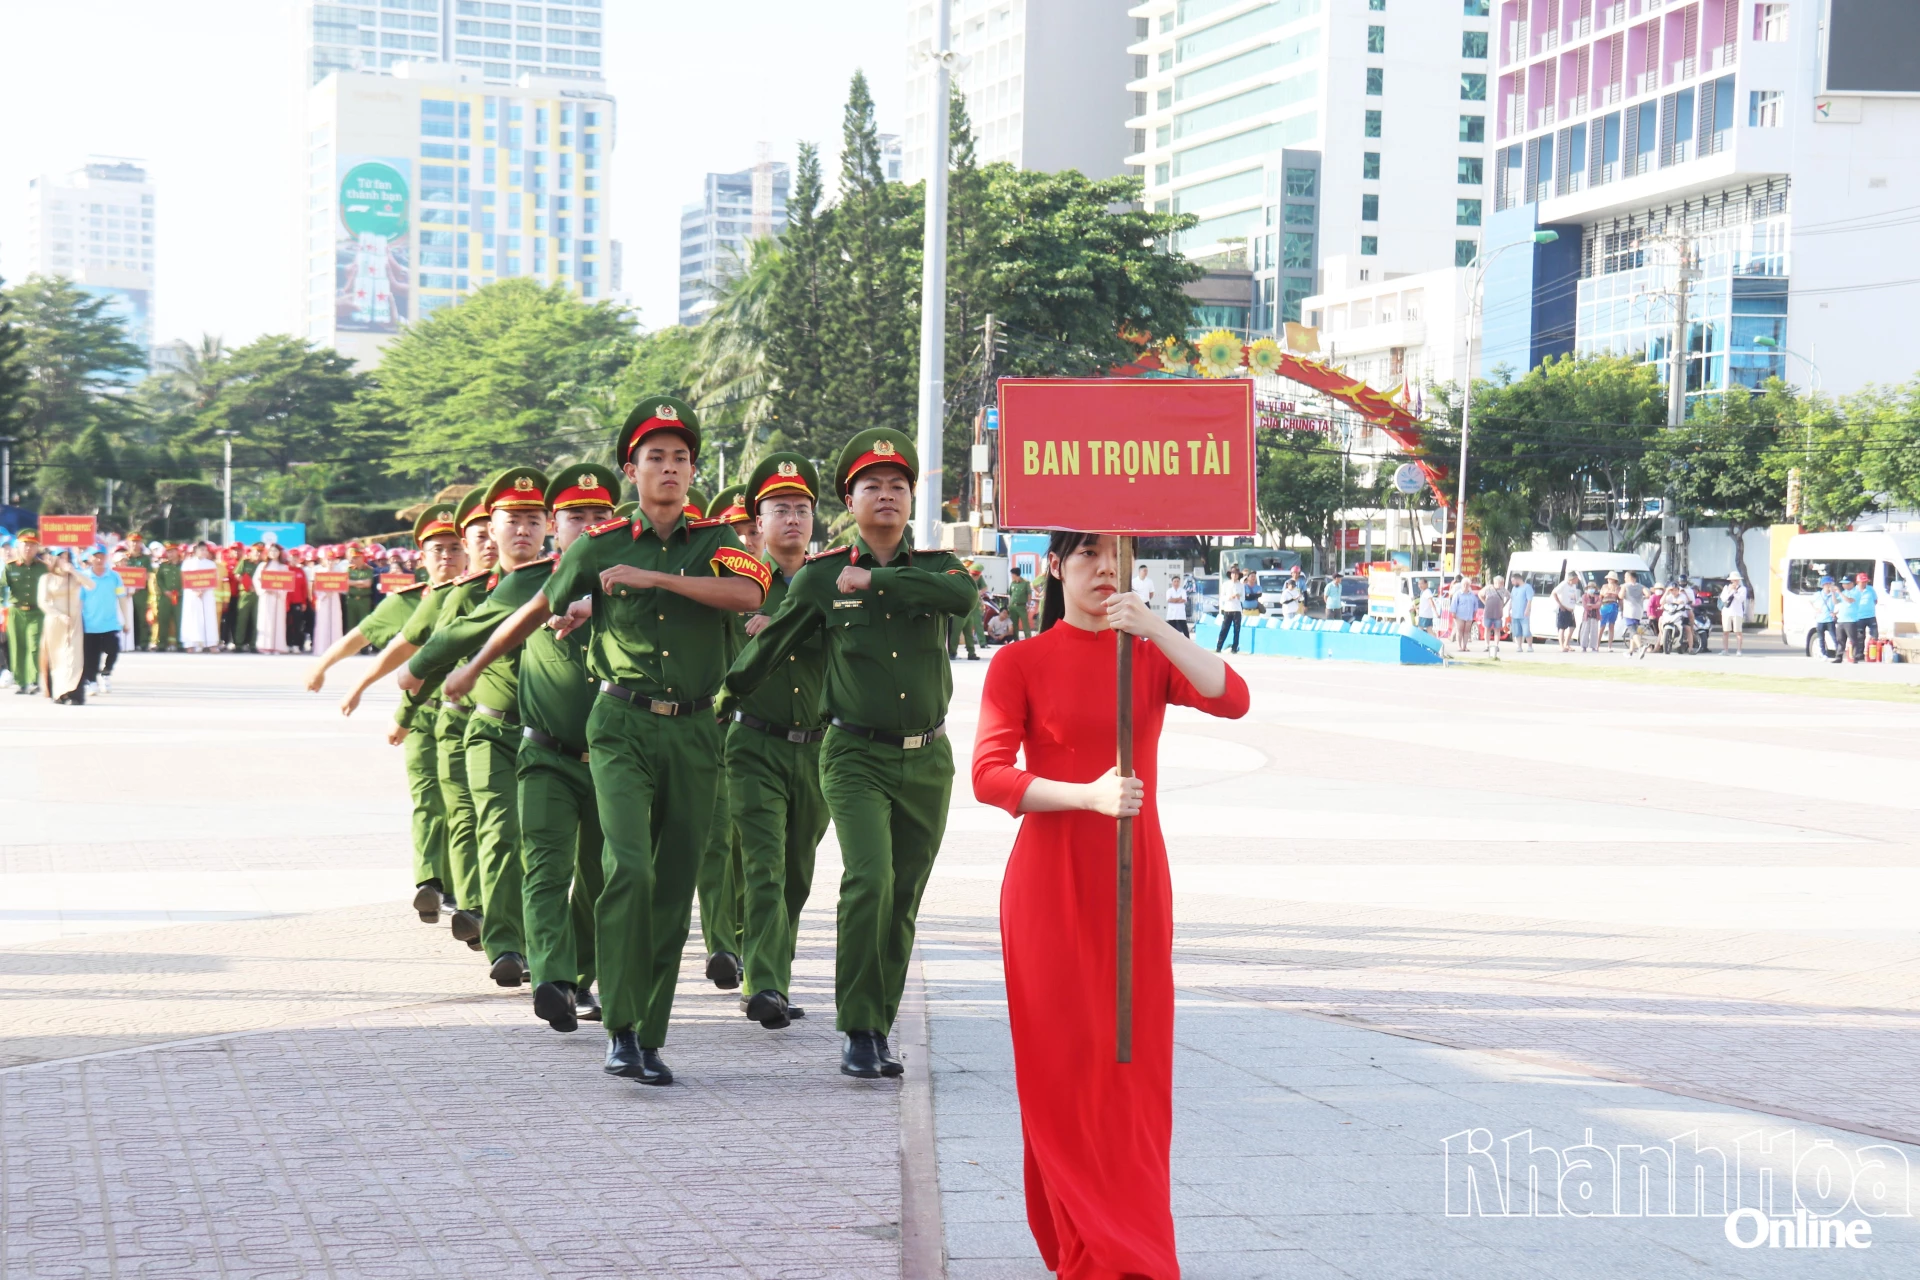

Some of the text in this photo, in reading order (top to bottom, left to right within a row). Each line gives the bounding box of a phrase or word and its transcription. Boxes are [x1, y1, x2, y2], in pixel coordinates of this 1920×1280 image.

[374, 179, 392, 190] fan
[1023, 433, 1230, 483] BAN TRỌNG TÀI
